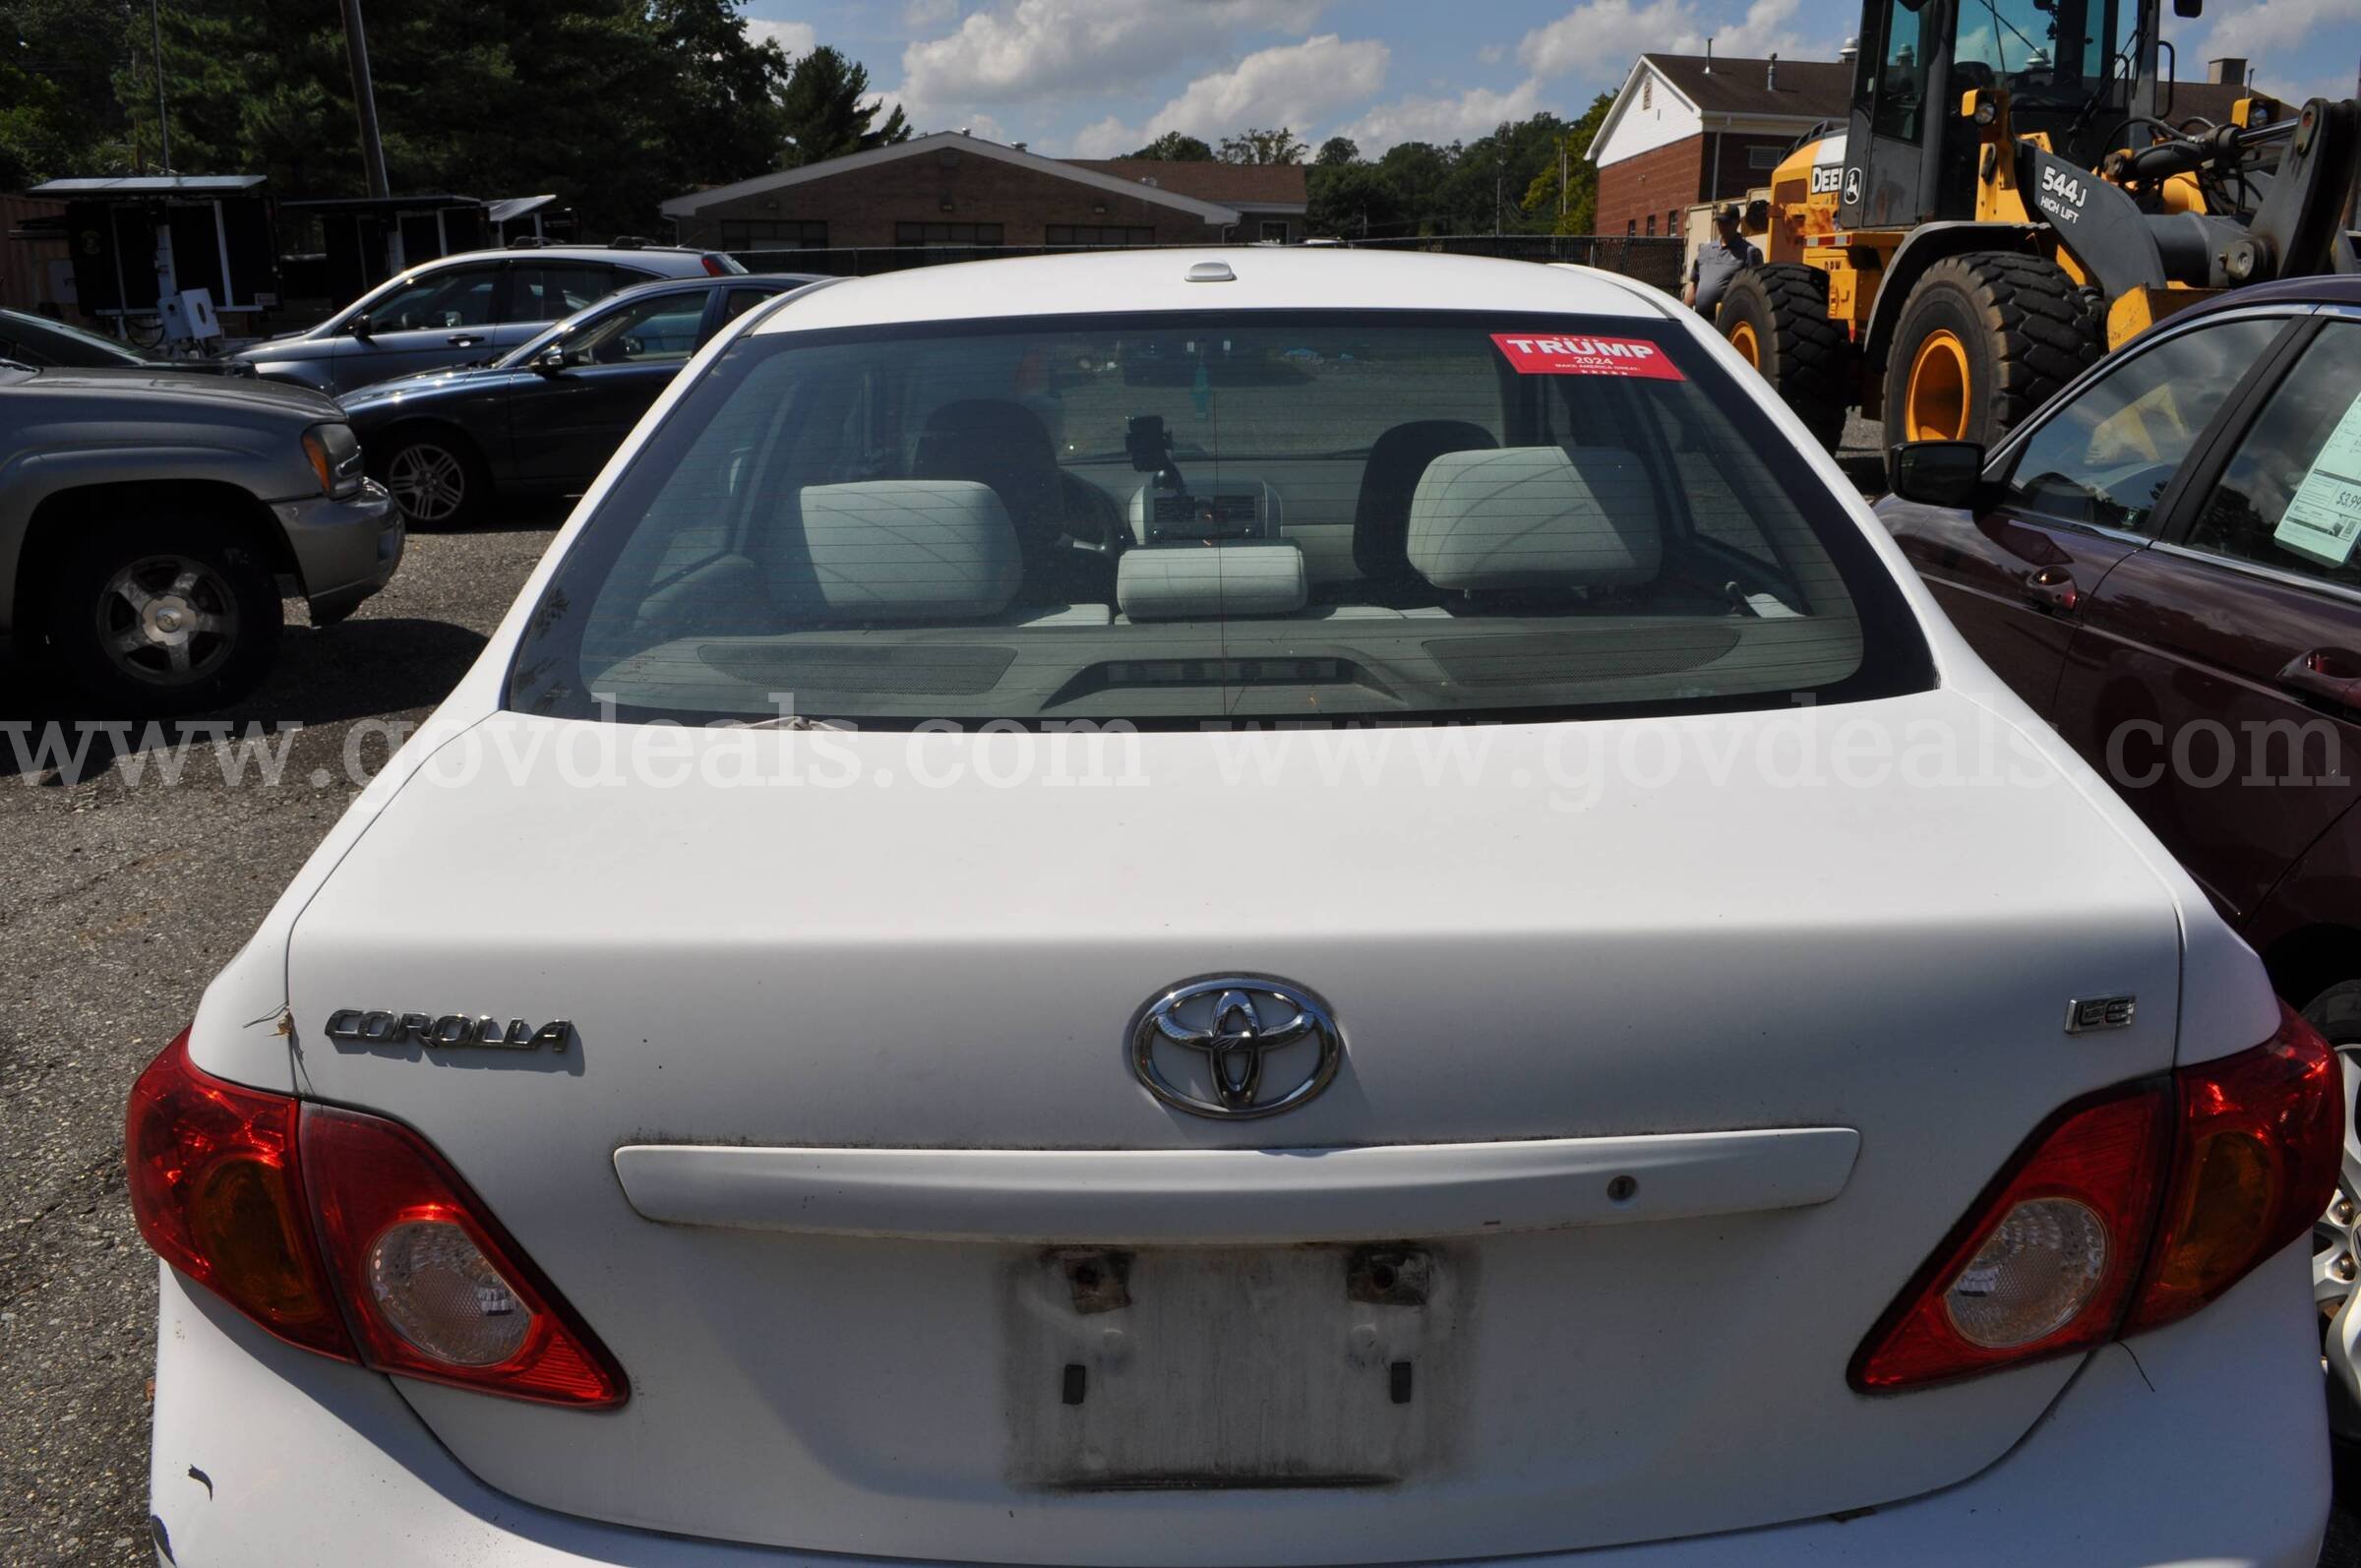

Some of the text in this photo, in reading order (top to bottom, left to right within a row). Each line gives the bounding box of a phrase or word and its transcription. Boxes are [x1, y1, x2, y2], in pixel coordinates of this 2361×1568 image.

[2042, 165, 2087, 208] 544J
[2040, 195, 2080, 224] HIGH LIFT
[1506, 339, 1654, 359] TRUMP
[1574, 356, 1613, 365] 2024
[2076, 996, 2131, 1029] LE
[325, 1009, 573, 1053] COROLLA
